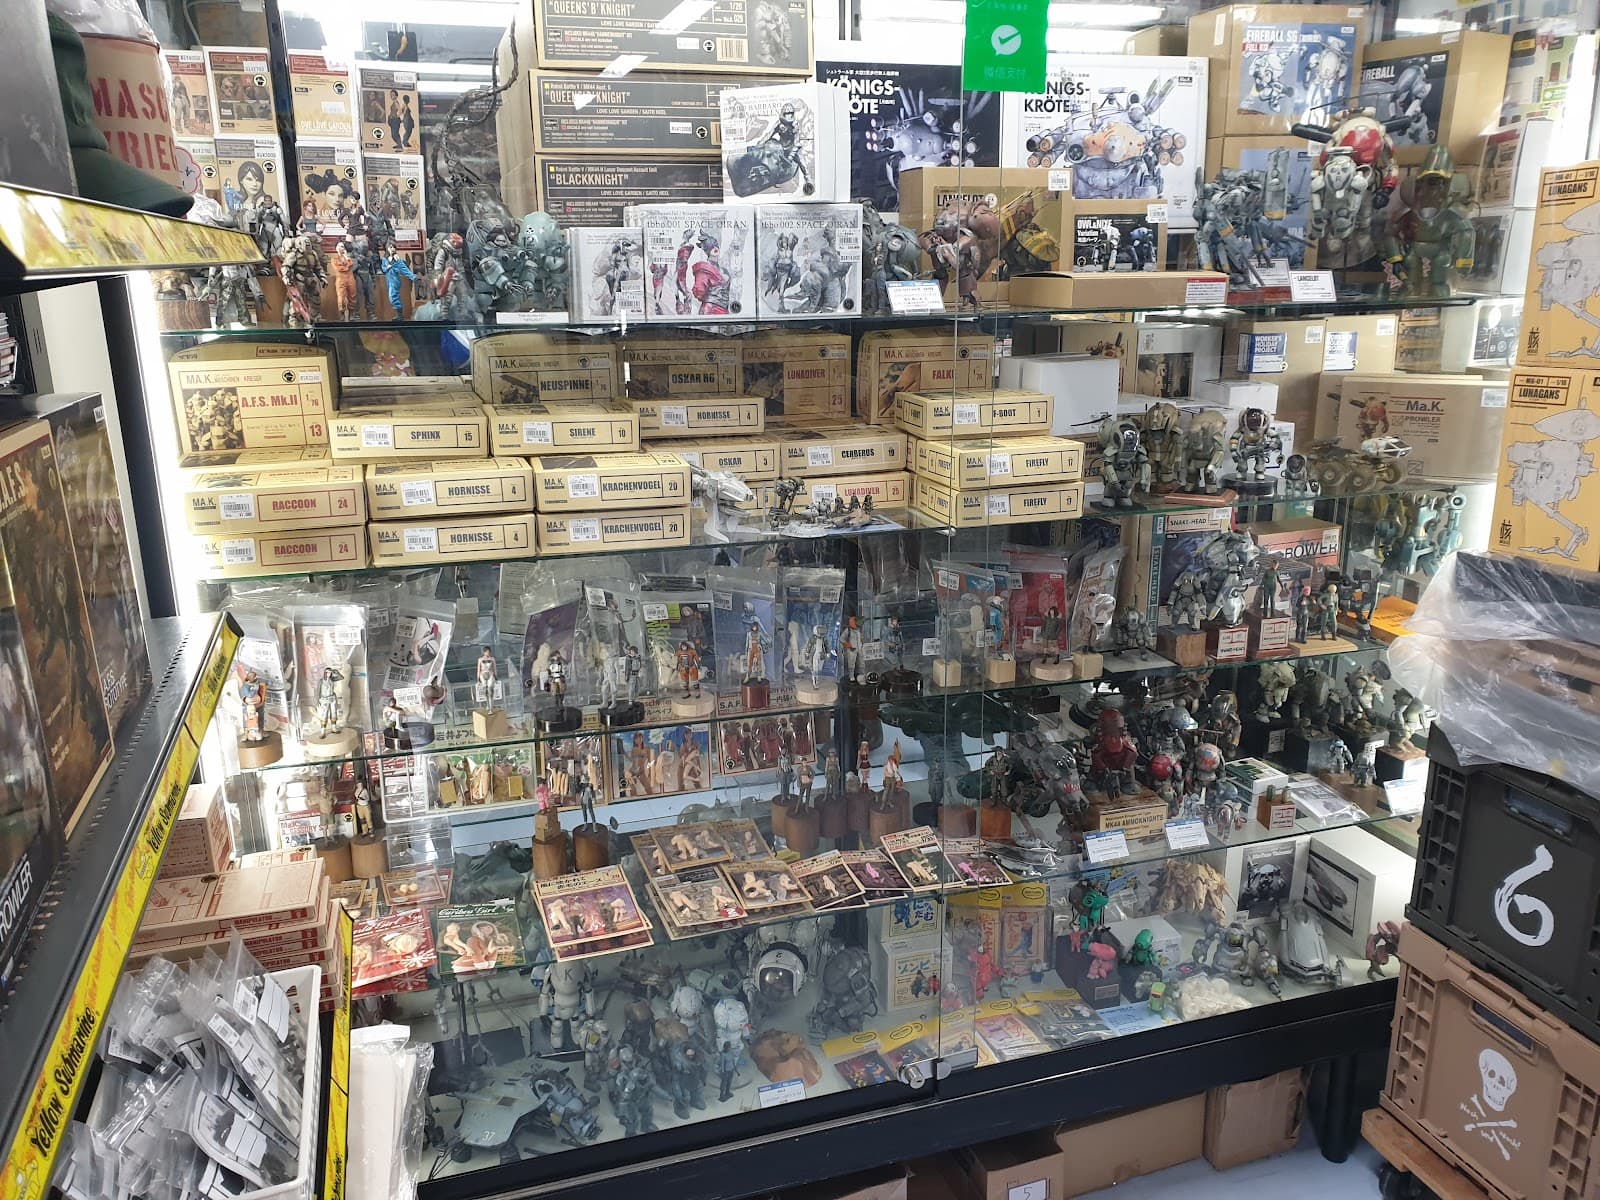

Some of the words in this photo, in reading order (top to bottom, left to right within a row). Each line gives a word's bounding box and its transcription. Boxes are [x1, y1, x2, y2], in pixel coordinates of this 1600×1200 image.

[1024, 95, 1071, 113] KRÖTE
[540, 380, 591, 391] NEUSPINNE
[1406, 400, 1444, 412] Ma.K.
[309, 424, 323, 437] 13
[410, 430, 441, 441] SPHINX
[618, 429, 626, 438] 10
[464, 432, 473, 441] 15
[841, 448, 875, 459] CERBERUS
[718, 457, 742, 467] OSKAR
[1025, 457, 1049, 468] FIREFLY
[448, 485, 491, 496] HORNISSE
[511, 486, 517, 495] 4
[602, 480, 662, 492] KRACHENVOGEL
[668, 481, 678, 491] 20
[272, 498, 317, 511] RACCOON
[337, 498, 349, 509] 24
[1023, 497, 1047, 507] FIREFLY
[603, 523, 663, 534] KRACHENVOGEL
[668, 524, 679, 533] 20
[450, 532, 494, 543] HORNISSE
[513, 533, 519, 542] 4
[274, 543, 318, 556] RACCOON
[338, 543, 349, 553] 24
[1494, 843, 1555, 947] 6
[30, 1093, 64, 1158] Yellow
[54, 1007, 96, 1097] Submarine
